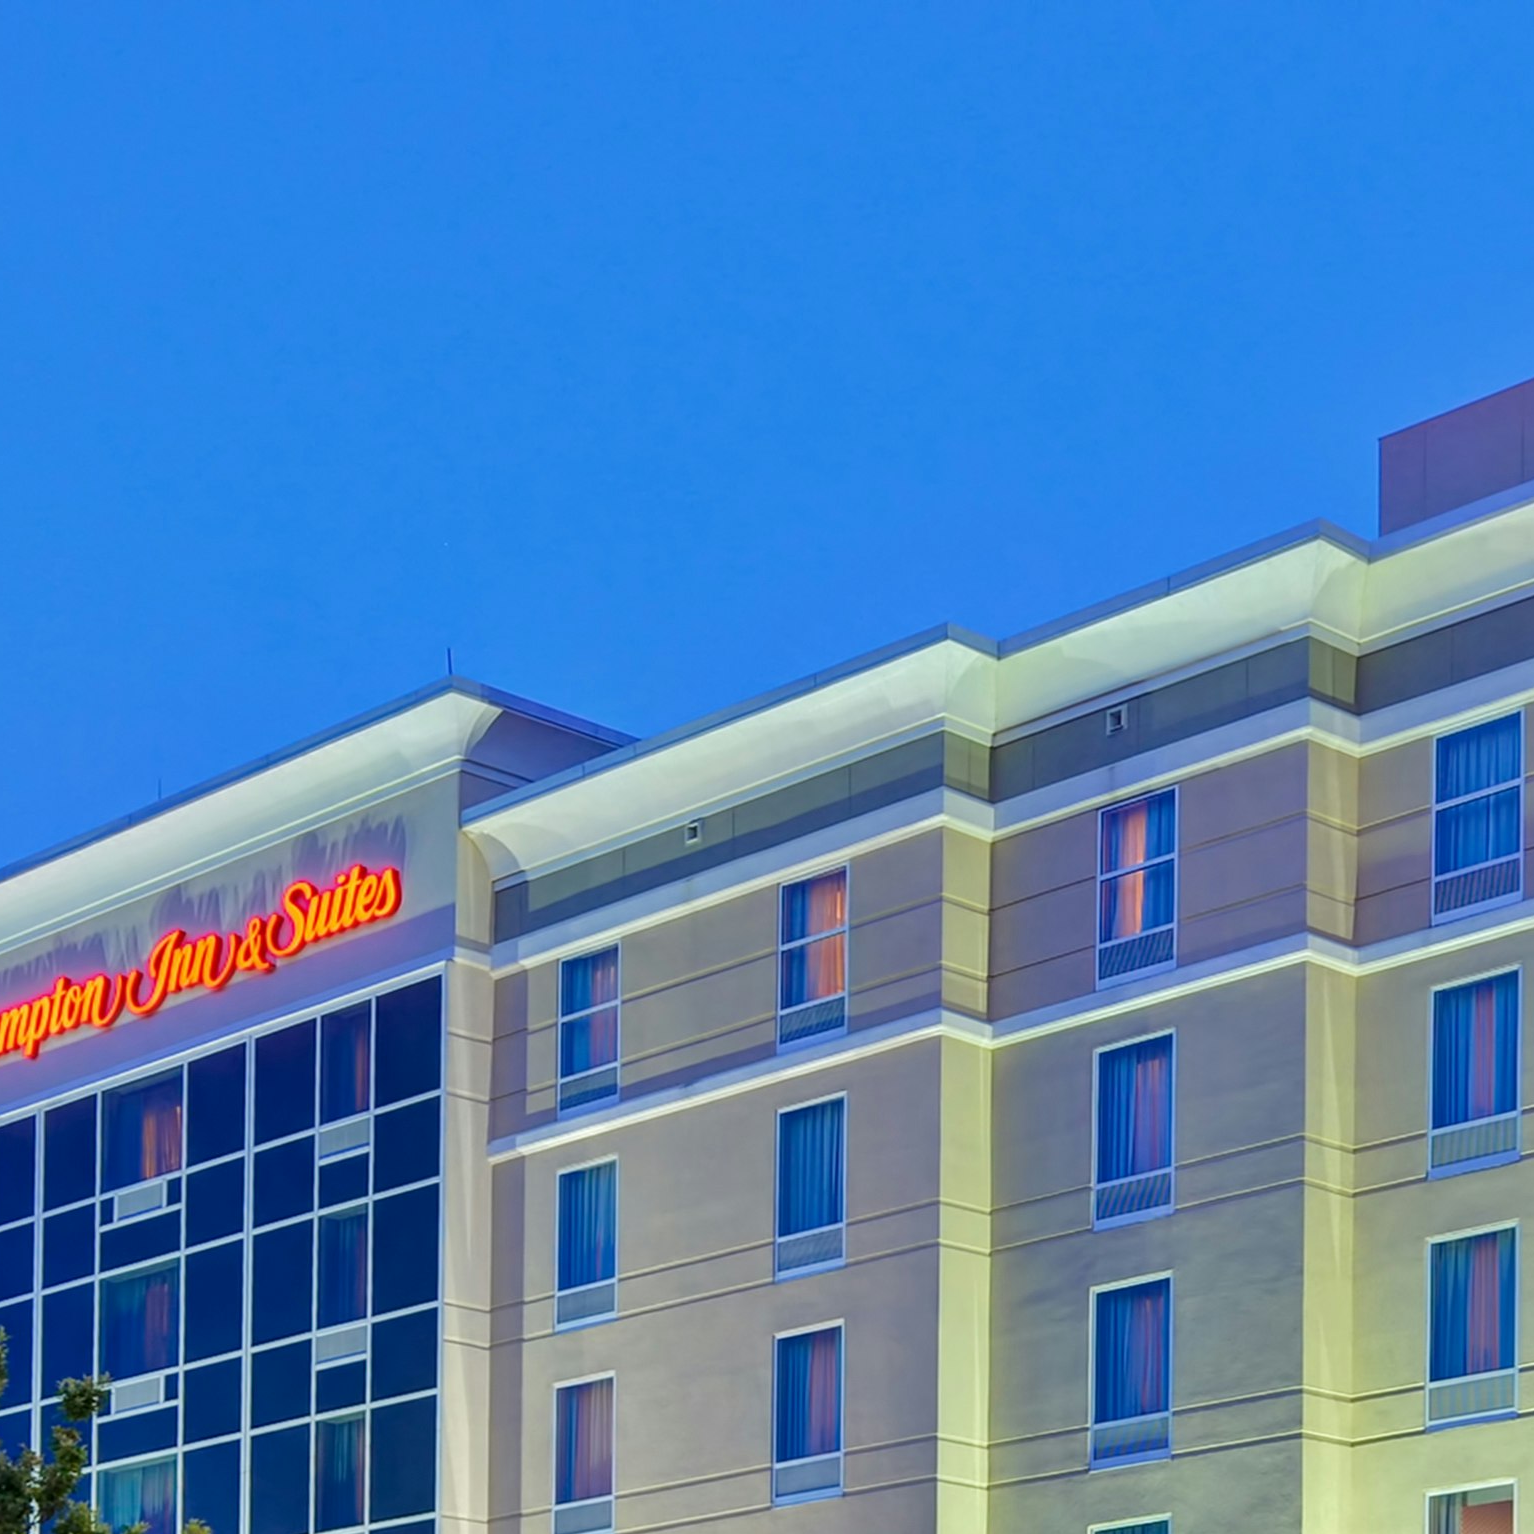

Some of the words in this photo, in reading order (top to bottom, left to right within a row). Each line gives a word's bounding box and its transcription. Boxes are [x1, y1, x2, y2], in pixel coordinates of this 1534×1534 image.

[124, 929, 236, 1015] Inn
[236, 918, 274, 972] &
[267, 864, 402, 958] Suites
